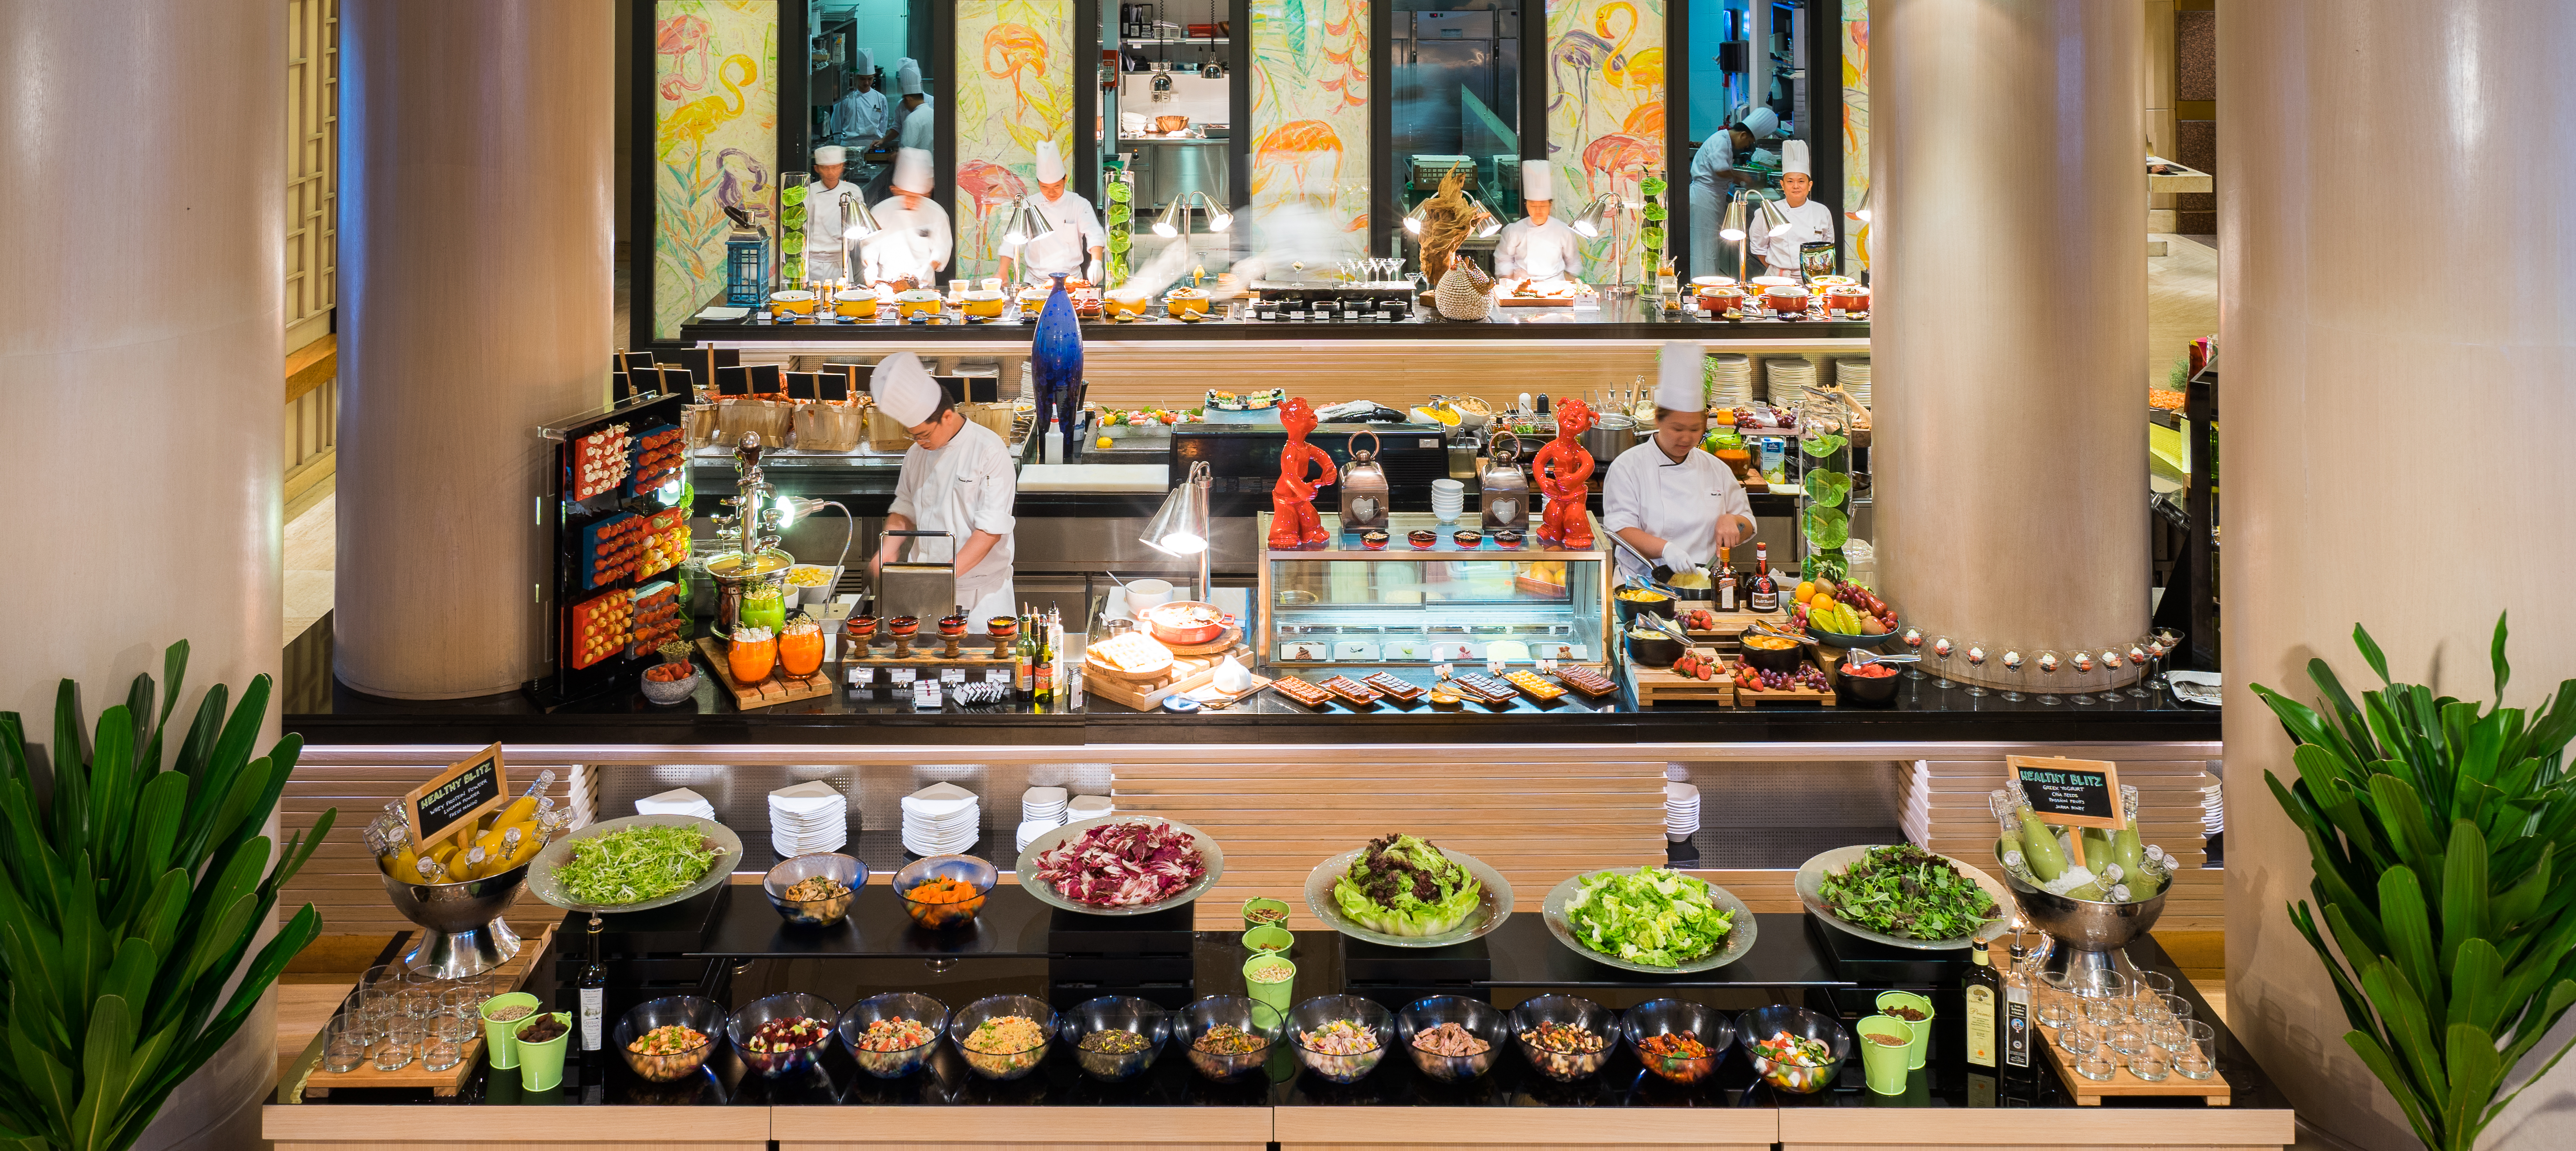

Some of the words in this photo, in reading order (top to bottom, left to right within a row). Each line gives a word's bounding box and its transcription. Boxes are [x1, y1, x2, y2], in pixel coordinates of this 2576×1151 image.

[421, 778, 462, 810] HEALTHY
[464, 762, 491, 784] BLITZ
[2020, 771, 2065, 784] HEALTHY
[2070, 774, 2103, 787] BLITZ
[430, 804, 444, 815] WHEY
[446, 791, 466, 806] PROTEIN
[468, 779, 487, 793] POWDER
[462, 791, 480, 803] POWDER
[449, 809, 462, 818] FRESH
